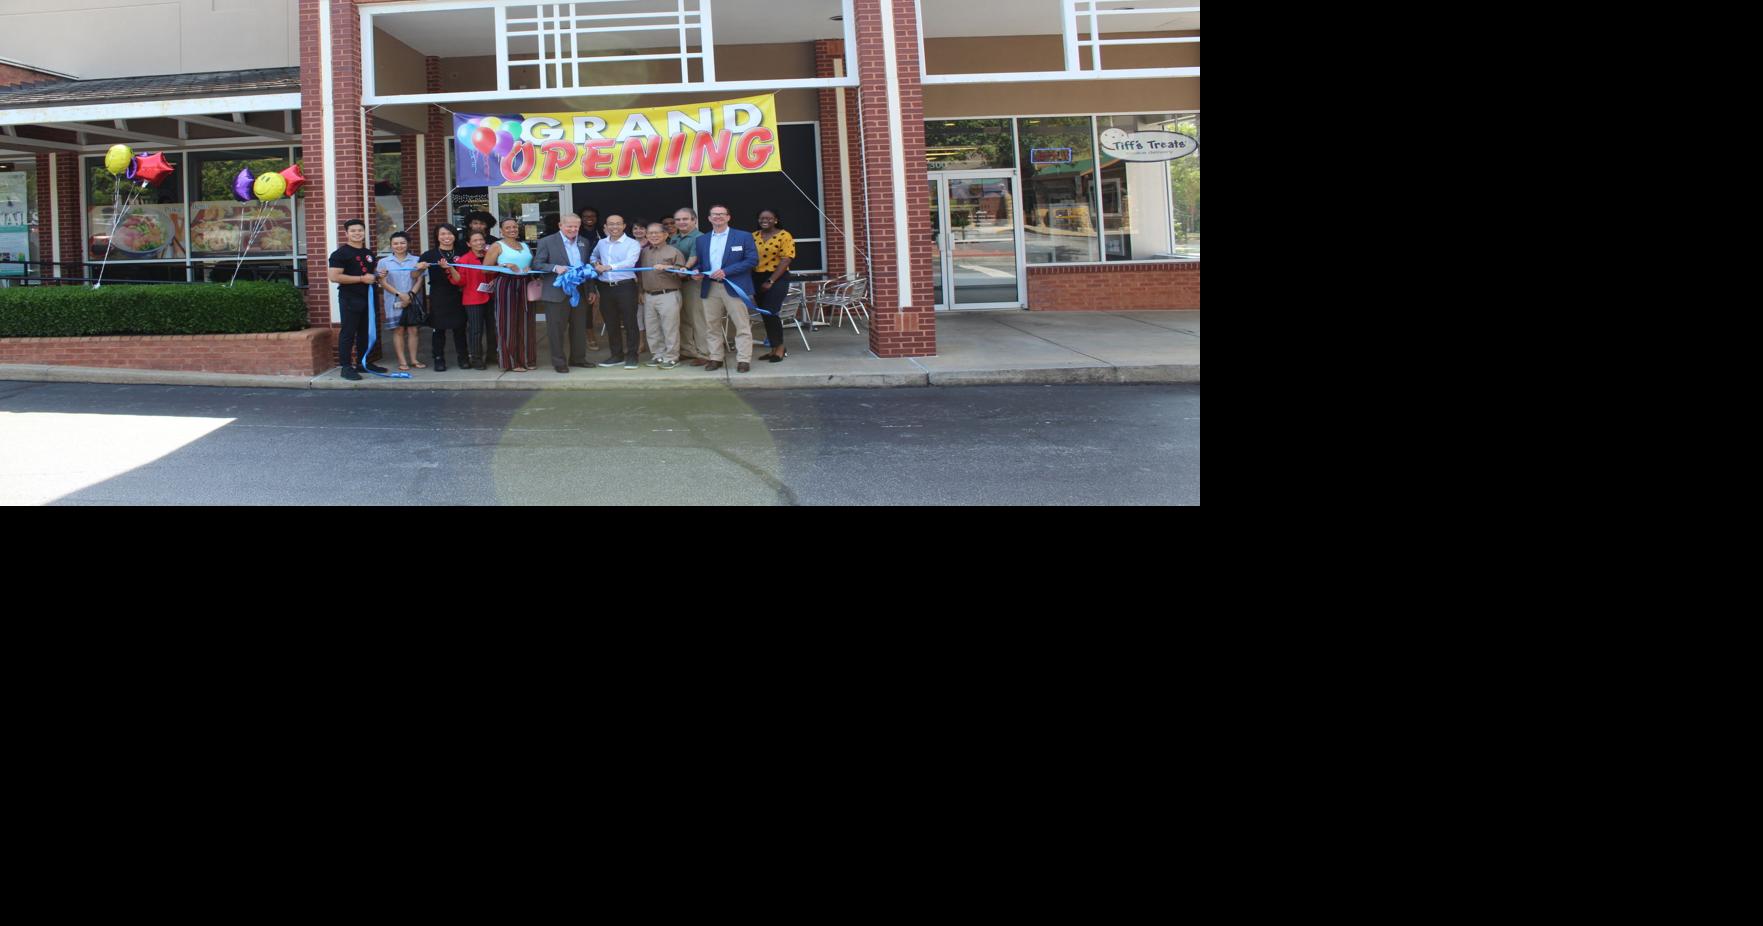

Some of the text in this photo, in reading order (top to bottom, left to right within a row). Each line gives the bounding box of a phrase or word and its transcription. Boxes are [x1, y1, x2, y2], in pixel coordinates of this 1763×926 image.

[520, 103, 763, 146] GRAND
[1112, 140, 1186, 151] Tiff's Treats
[500, 127, 775, 183] OPENING
